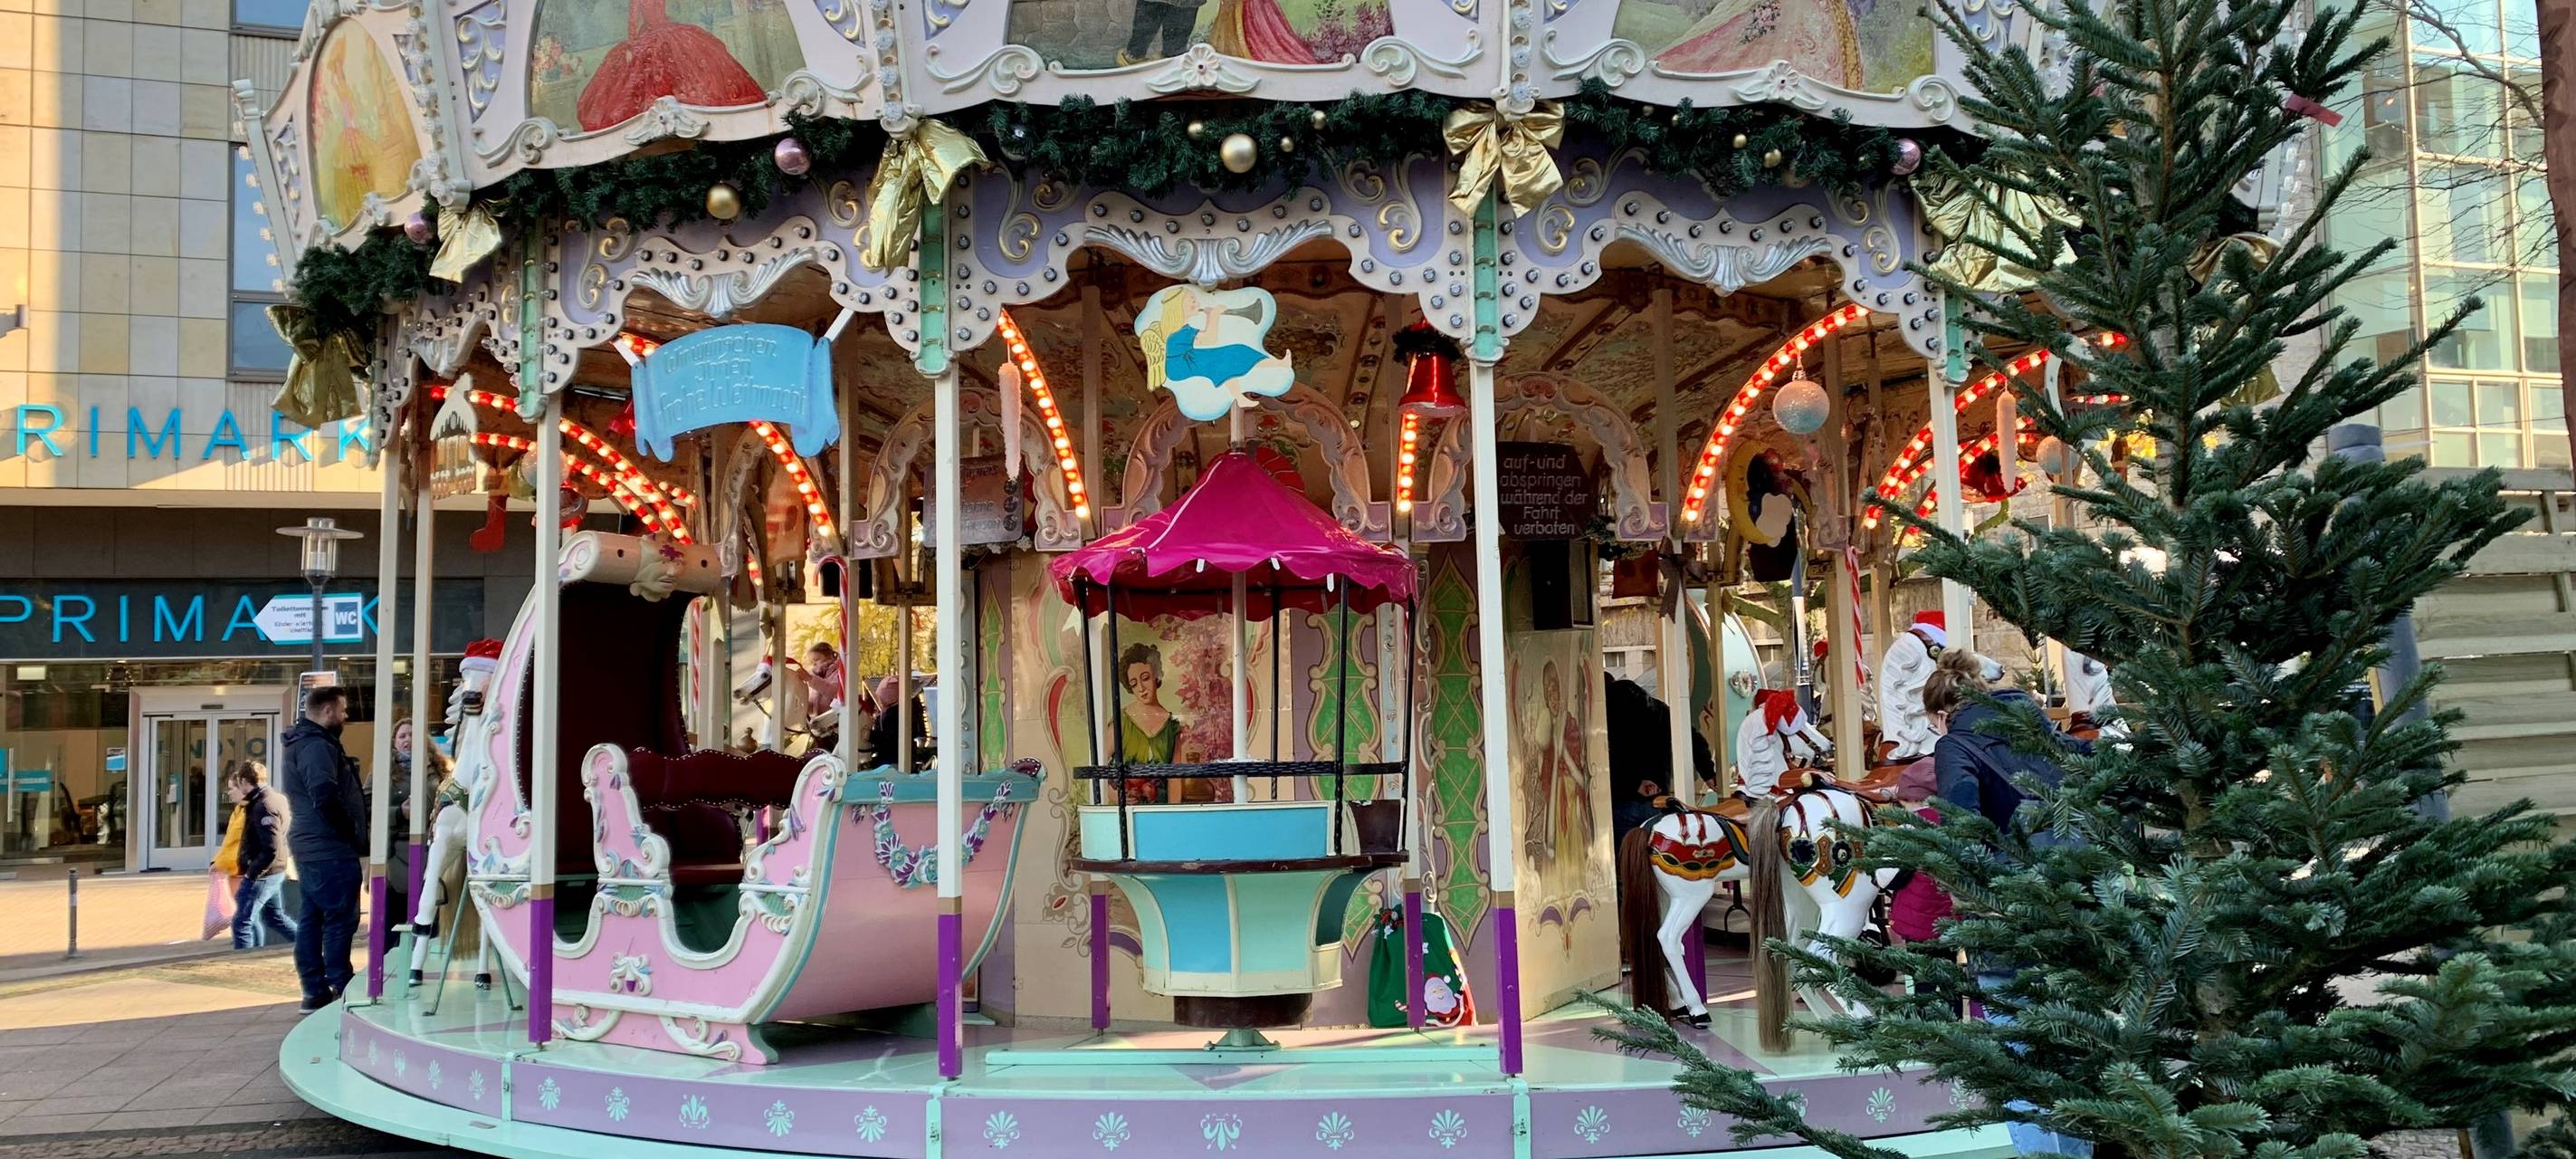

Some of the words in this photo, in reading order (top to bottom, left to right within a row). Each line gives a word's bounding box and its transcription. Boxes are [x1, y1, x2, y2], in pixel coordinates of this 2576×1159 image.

[16, 404, 372, 460] RIMARK
[1500, 472, 1581, 490] abspringen
[1500, 490, 1560, 504] während
[1564, 490, 1588, 504] der
[1523, 506, 1561, 520] Fahrt
[1513, 522, 1576, 535] verboten
[335, 611, 358, 625] WC
